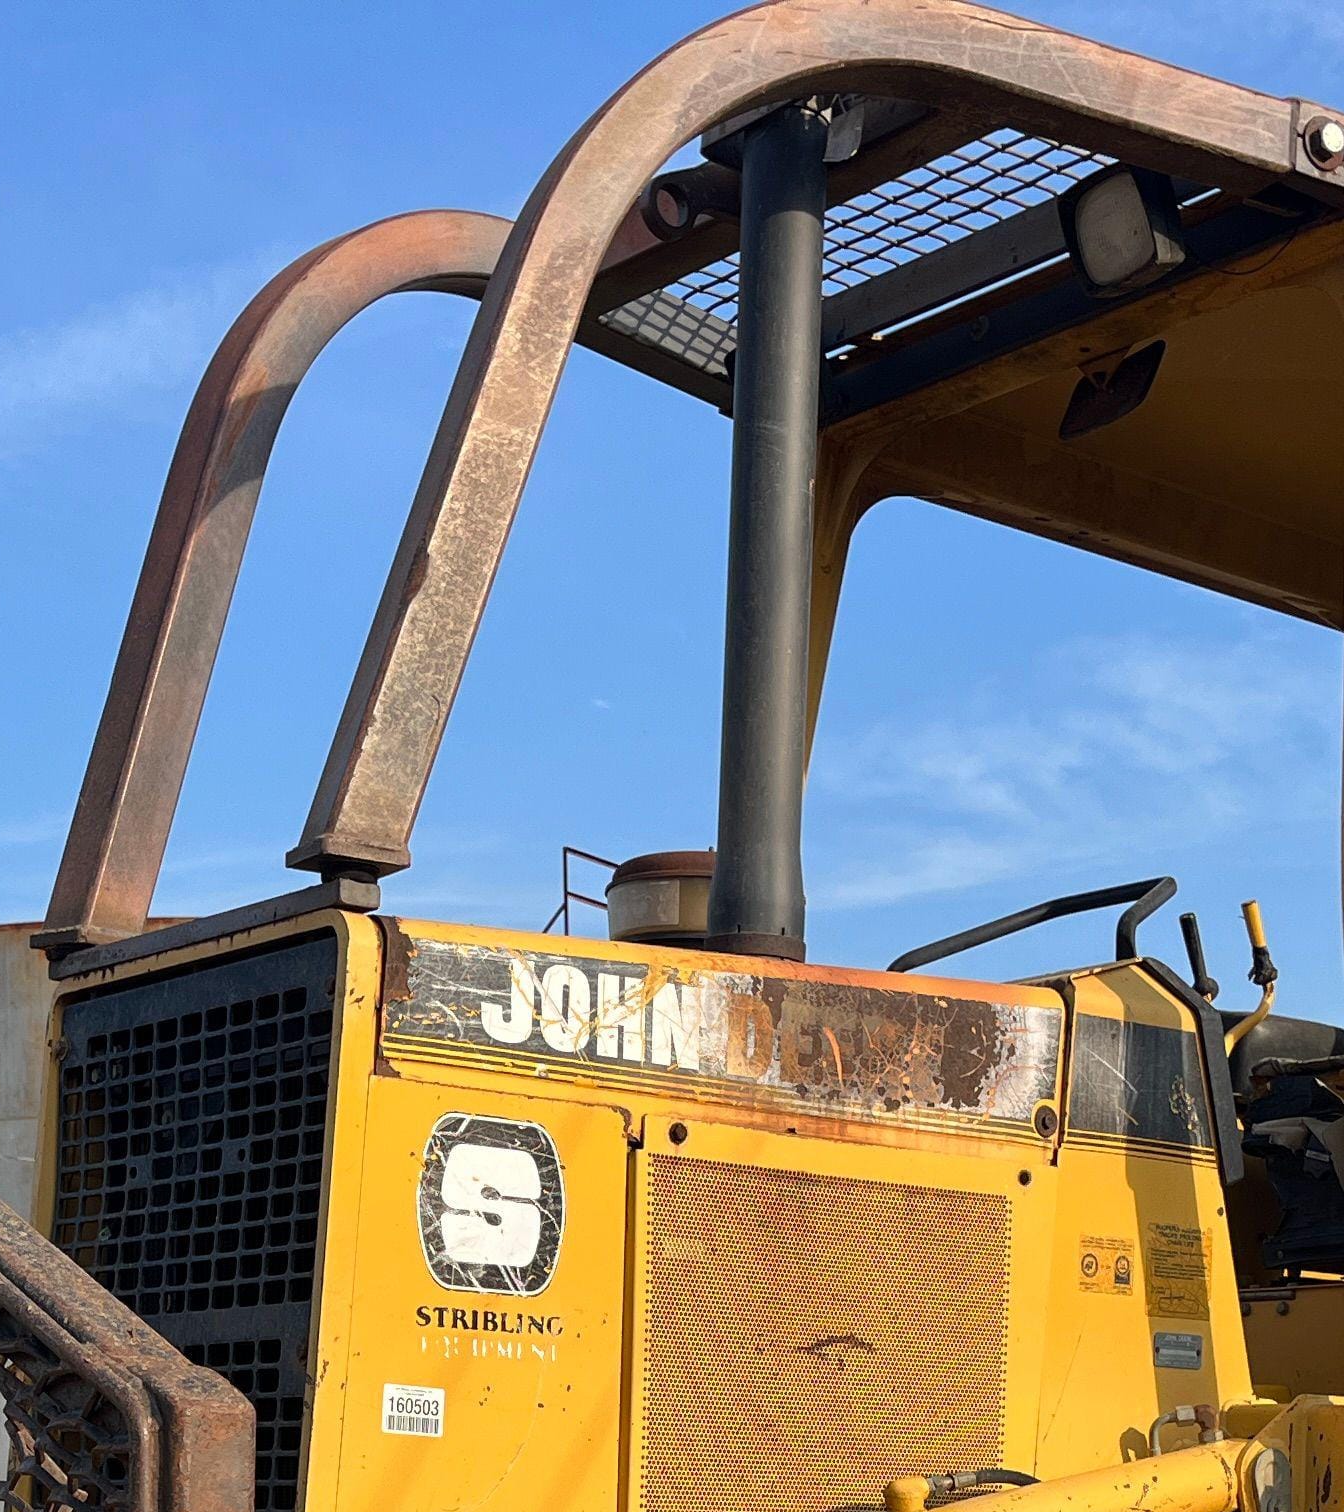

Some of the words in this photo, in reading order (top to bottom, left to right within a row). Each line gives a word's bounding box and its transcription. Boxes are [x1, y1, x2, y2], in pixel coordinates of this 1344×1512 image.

[481, 959, 700, 1073] JOHN
[416, 1305, 564, 1337] STRIBLING
[388, 1396, 440, 1417] 160503
